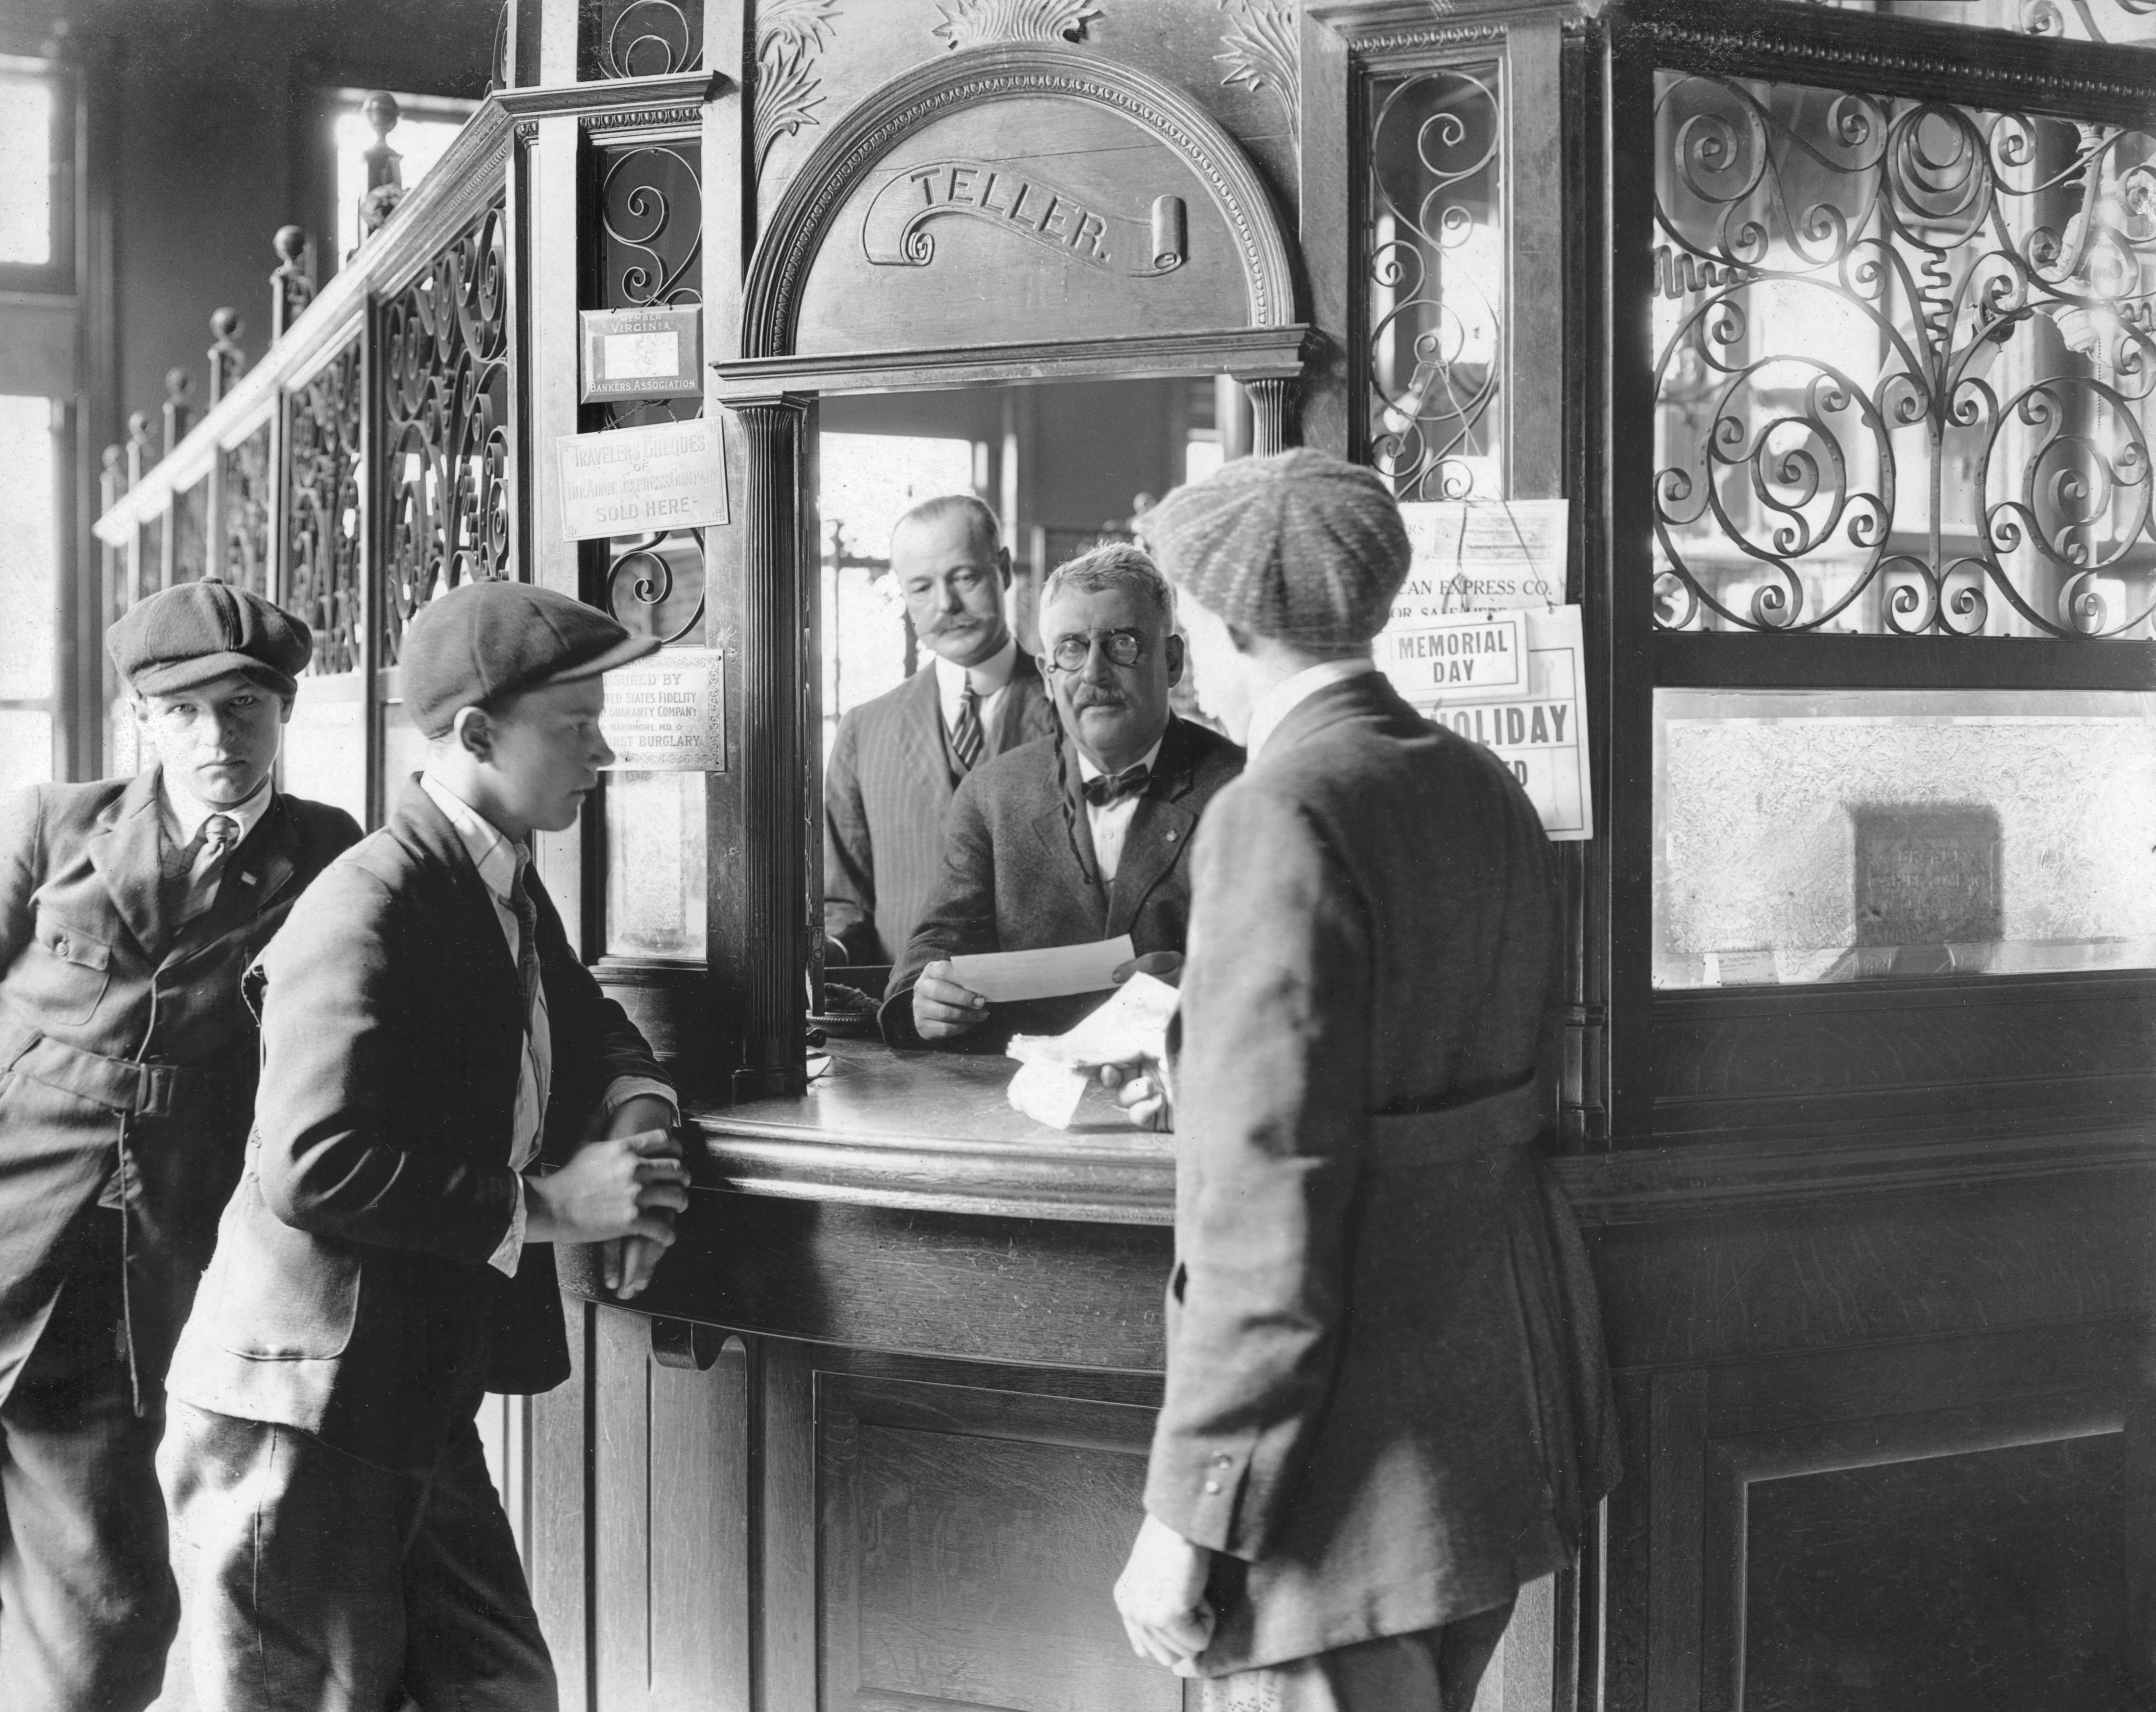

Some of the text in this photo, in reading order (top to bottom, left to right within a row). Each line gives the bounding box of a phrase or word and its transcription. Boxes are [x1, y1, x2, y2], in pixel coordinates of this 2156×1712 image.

[620, 314, 662, 322] MEMBER
[611, 321, 671, 333] VIRGINIA
[590, 382, 631, 392] BANKERS
[634, 379, 695, 390] ASSOCIATION
[572, 434, 706, 467] TRAVELERS CHEQUES
[633, 462, 649, 472] OF
[622, 474, 670, 494] EXPRESS
[671, 467, 719, 488] COMPANY
[596, 496, 690, 523] SOLD HERE
[1440, 580, 1516, 595] EXPRESS
[1523, 580, 1552, 595] CO.
[1398, 630, 1508, 659] MEMORIAL
[1433, 659, 1475, 684] DAY
[663, 674, 683, 685] BY
[626, 691, 656, 704] STATES
[659, 691, 697, 704] FIDELITY
[610, 707, 655, 718] GUARANTY
[658, 706, 697, 717] COMPANY
[639, 735, 700, 747] BURGLARY
